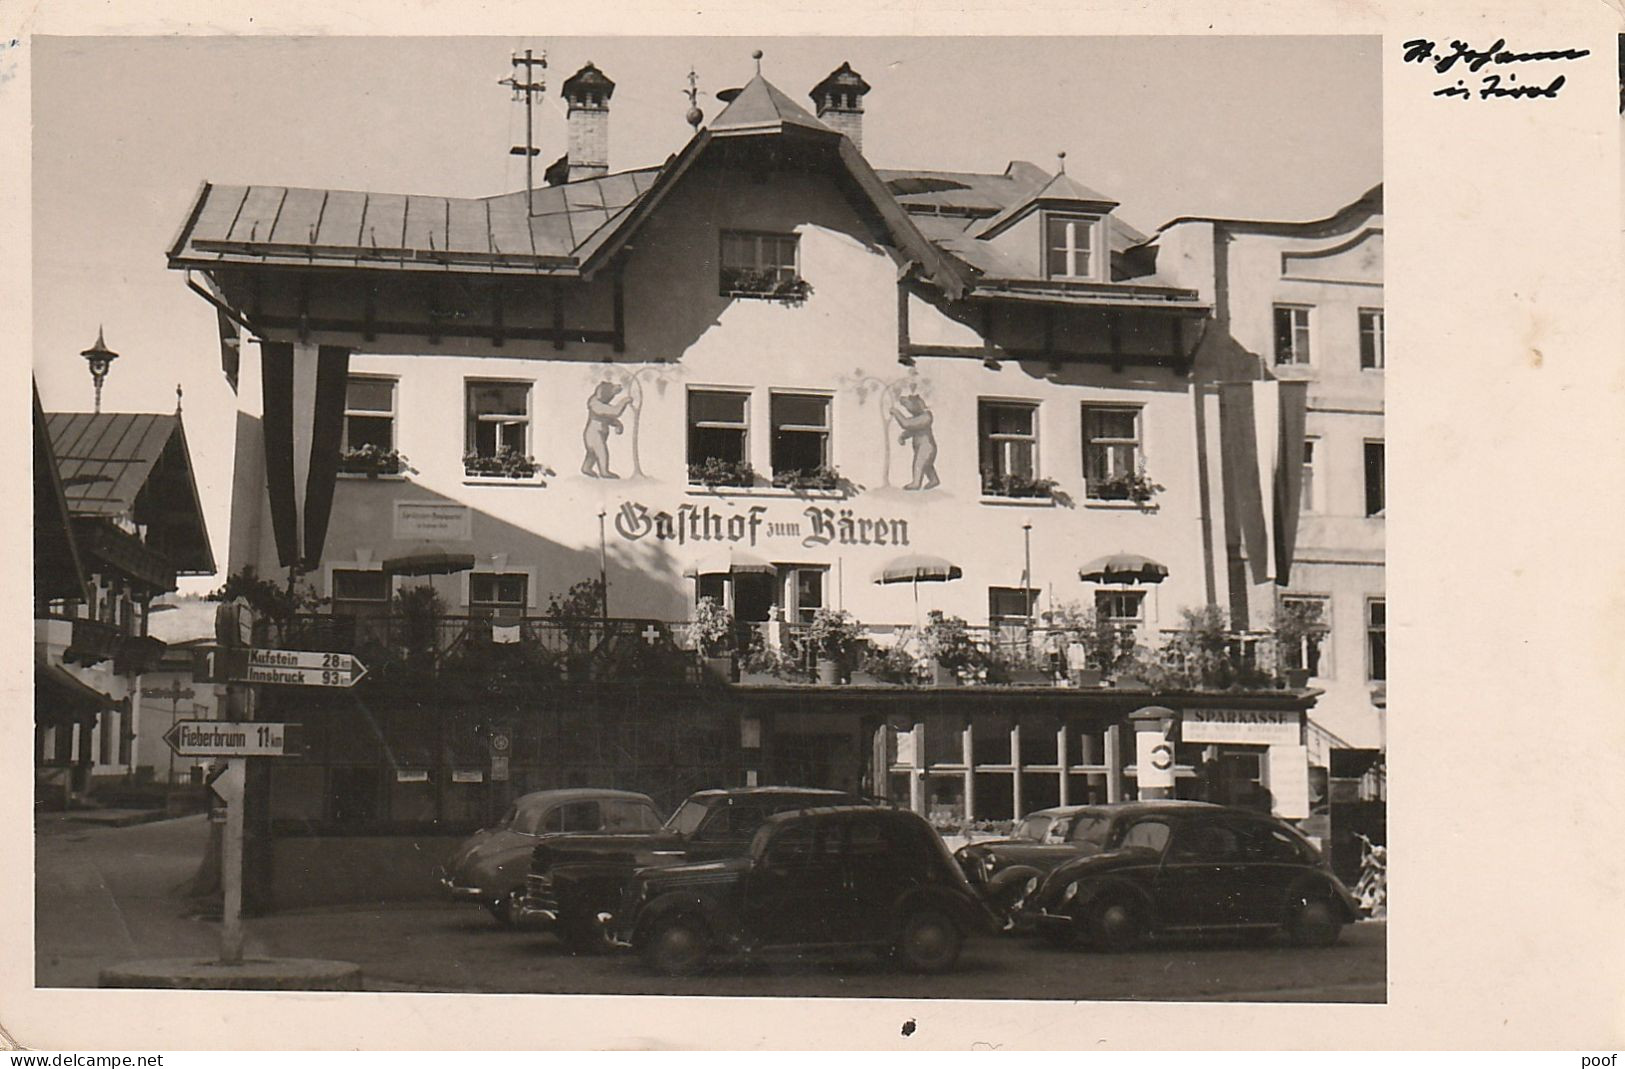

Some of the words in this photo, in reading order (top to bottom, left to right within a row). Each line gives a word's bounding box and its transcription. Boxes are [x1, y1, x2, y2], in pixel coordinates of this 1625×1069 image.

[1434, 38, 1591, 74] Johann
[1433, 79, 1471, 100] in
[1479, 74, 1567, 100] Tirol
[614, 500, 768, 547] Gasthof
[766, 518, 801, 538] zum
[801, 505, 910, 548] Bären
[206, 651, 215, 678] 1
[250, 650, 298, 666] Kufstein
[322, 653, 340, 668] 28
[249, 668, 305, 684] Innsbruck
[322, 671, 339, 685] 93
[1194, 710, 1288, 724] SPARKASSE
[181, 725, 246, 748] Fieberbrunn
[257, 726, 270, 748] 11
